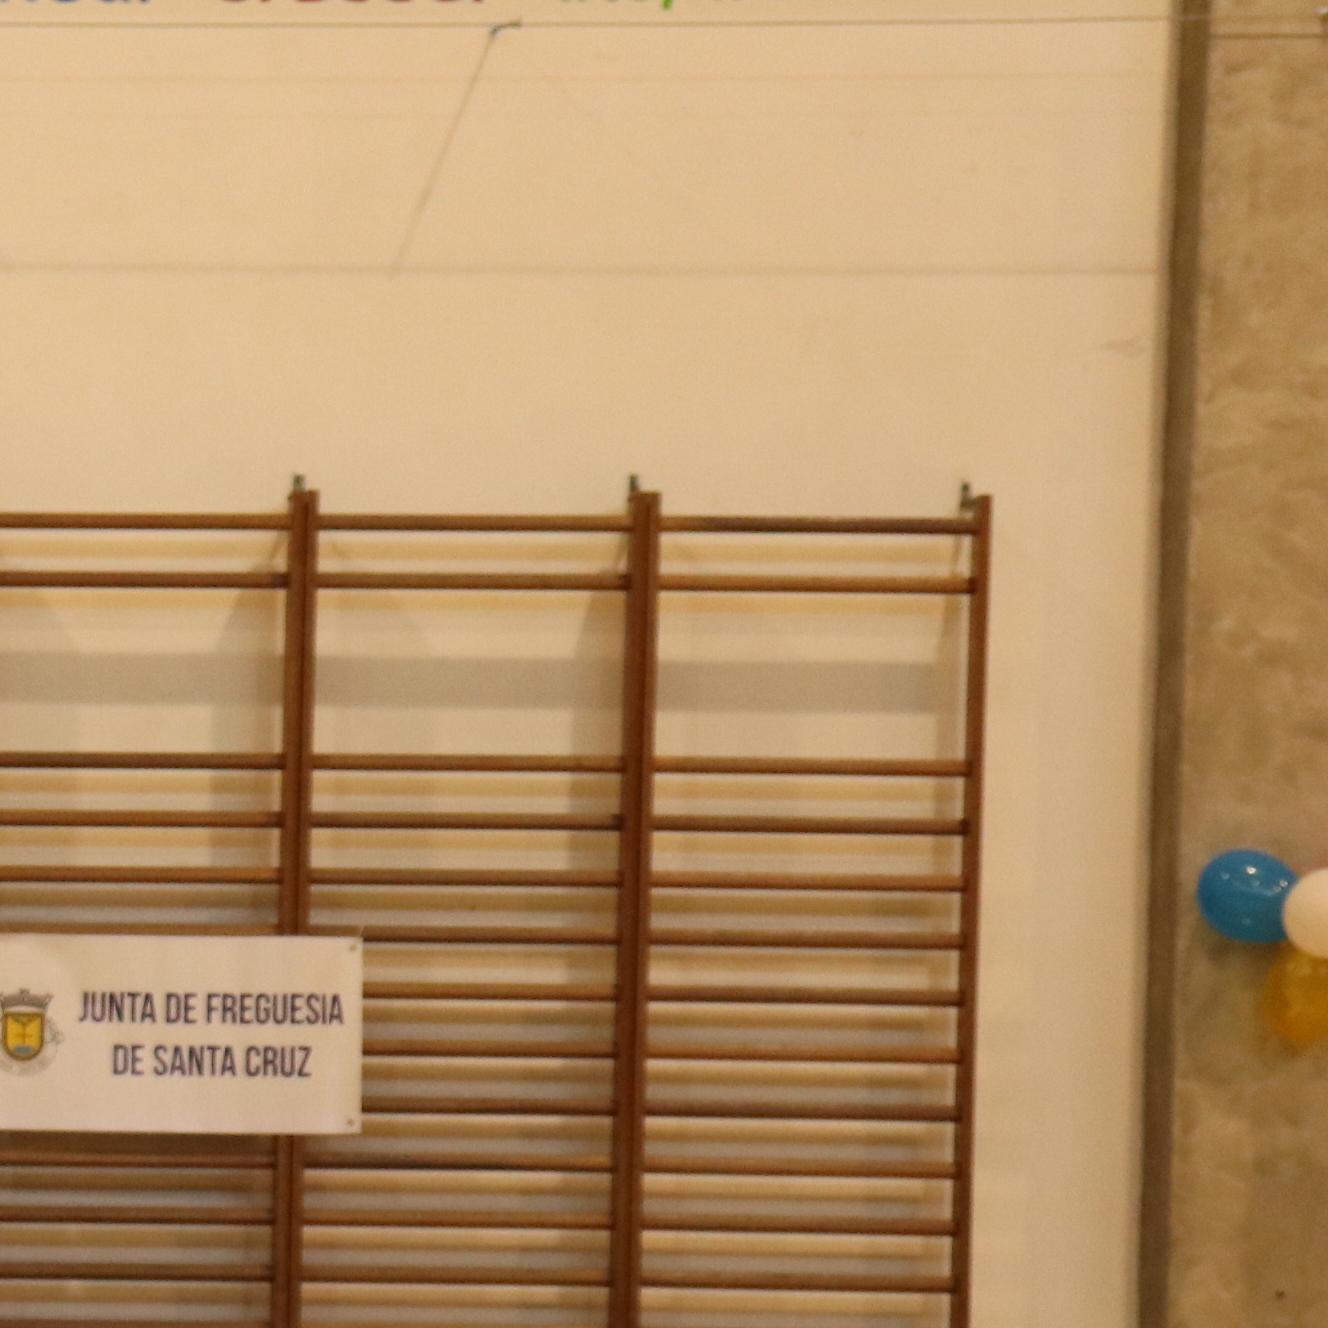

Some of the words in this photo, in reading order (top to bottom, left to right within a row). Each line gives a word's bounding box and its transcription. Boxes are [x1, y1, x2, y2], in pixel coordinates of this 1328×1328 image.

[78, 991, 156, 1023] JUNTA
[165, 992, 197, 1024] DE
[206, 992, 344, 1025] FREGUESIA
[112, 1044, 144, 1076] DE
[153, 1044, 236, 1077] SANTA
[245, 1045, 311, 1077] CRUZ
